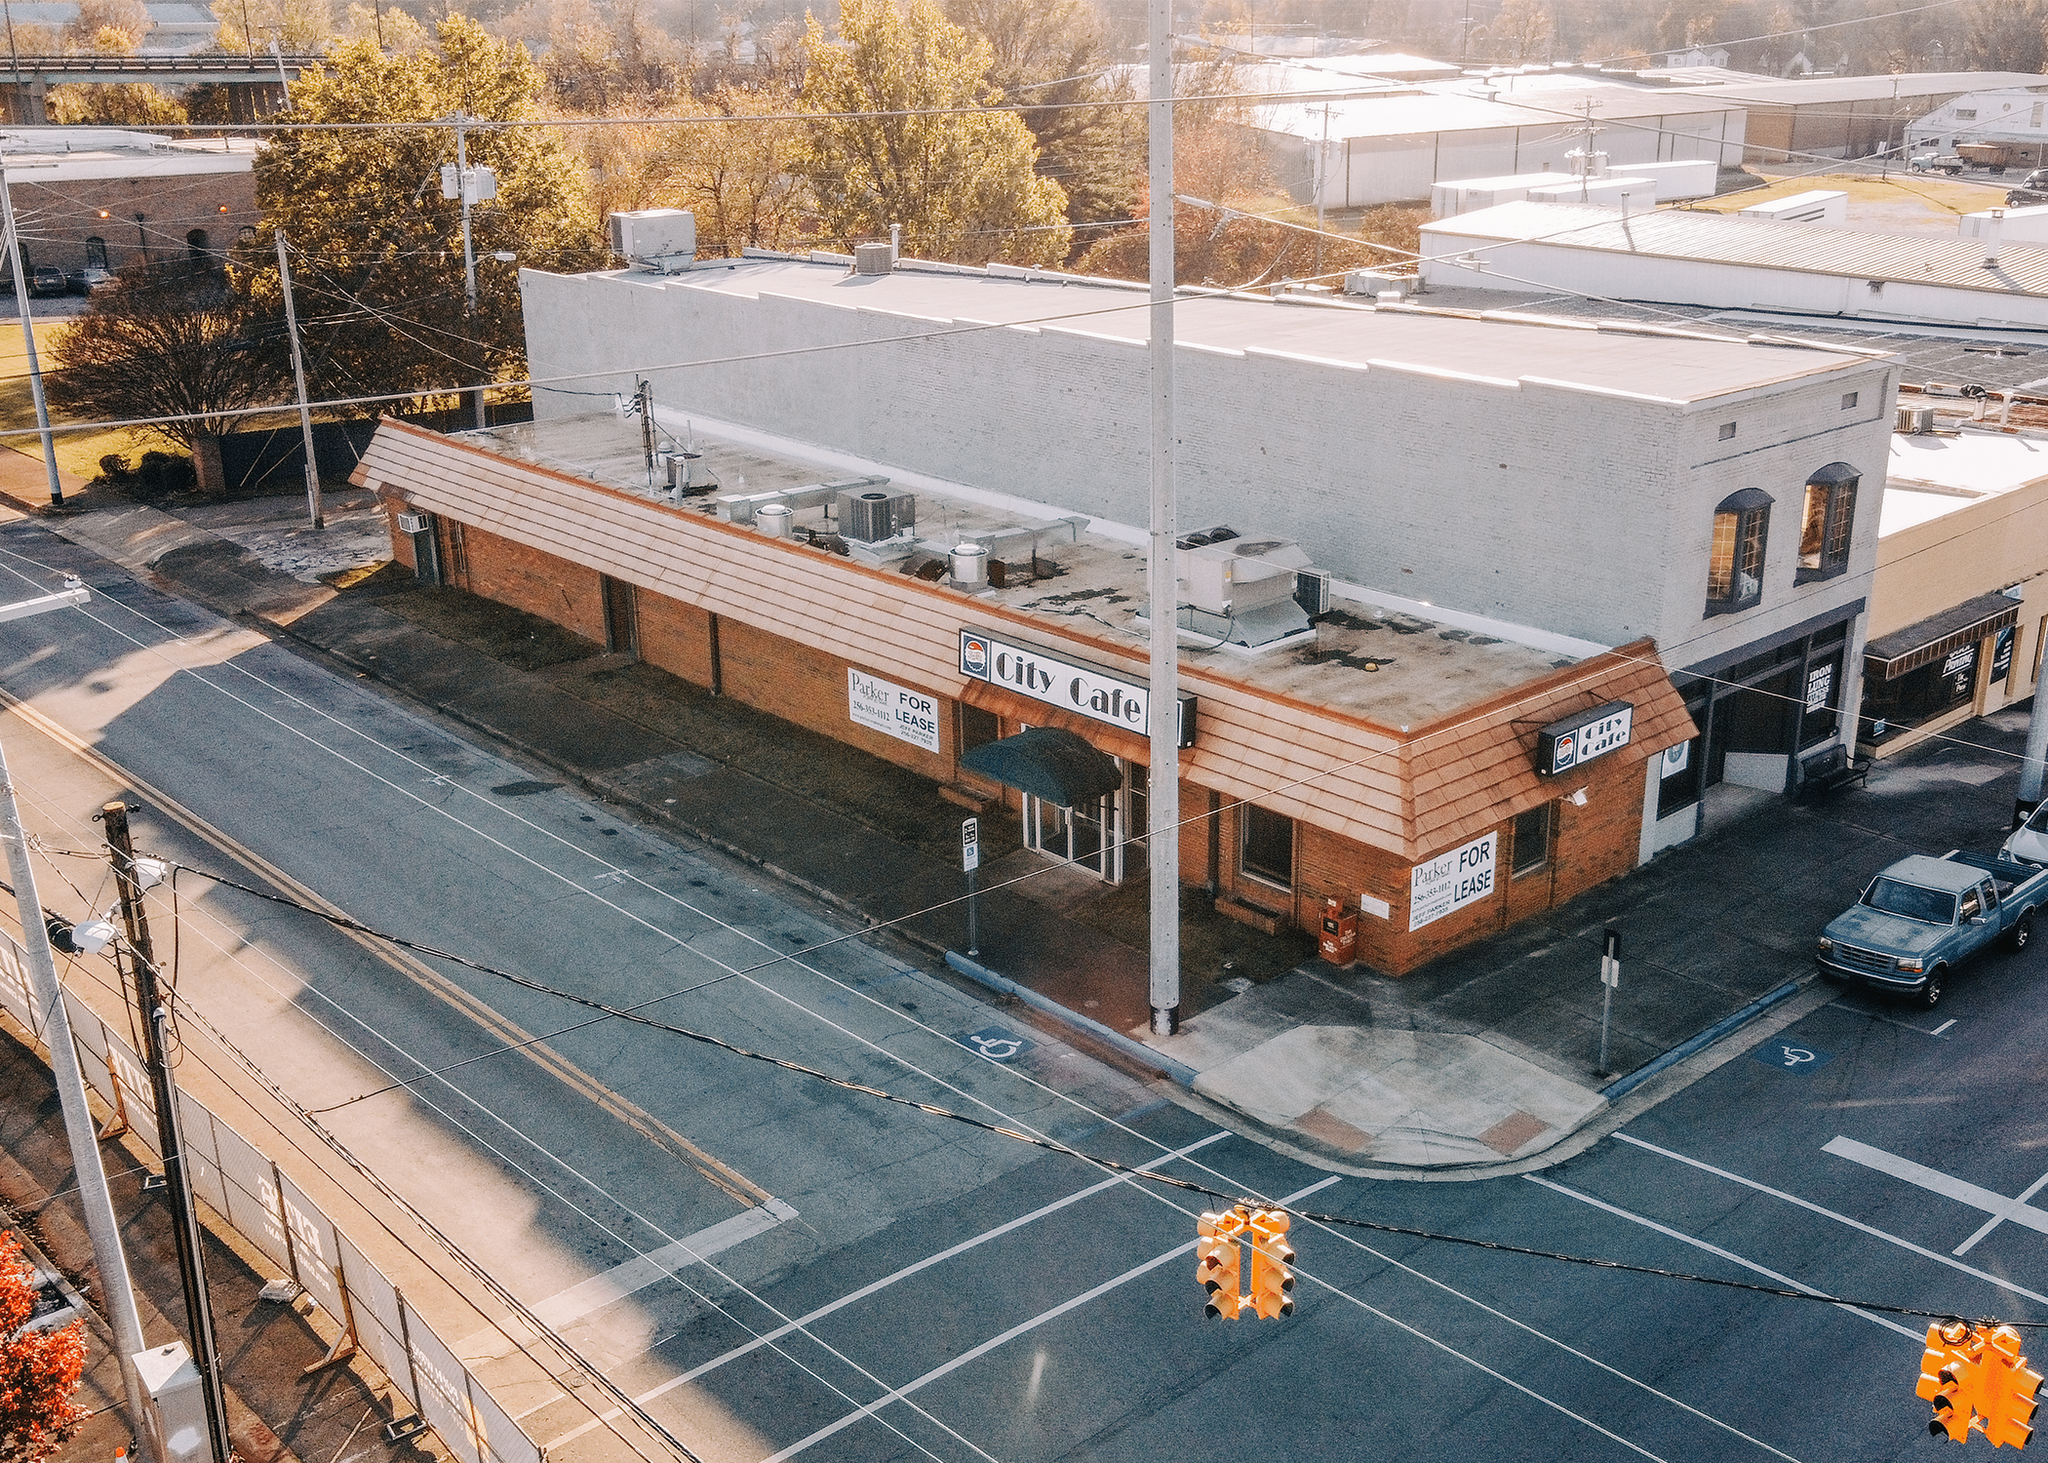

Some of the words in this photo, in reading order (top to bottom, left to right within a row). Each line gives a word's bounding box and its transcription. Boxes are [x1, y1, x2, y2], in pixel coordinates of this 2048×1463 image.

[1808, 674, 1831, 694] LUNG
[1809, 663, 1832, 682] IRON
[851, 673, 889, 702] Parker
[996, 652, 1056, 694] City
[1069, 677, 1141, 723] Cafe
[853, 700, 890, 722] 256-353-1112
[899, 692, 931, 715] FOR
[895, 708, 935, 734] LEASE
[1585, 716, 1624, 740] City
[1581, 730, 1626, 756] Cafe
[1459, 841, 1490, 873] FOR
[1414, 860, 1453, 887] Parker
[1454, 869, 1492, 903] LEASE
